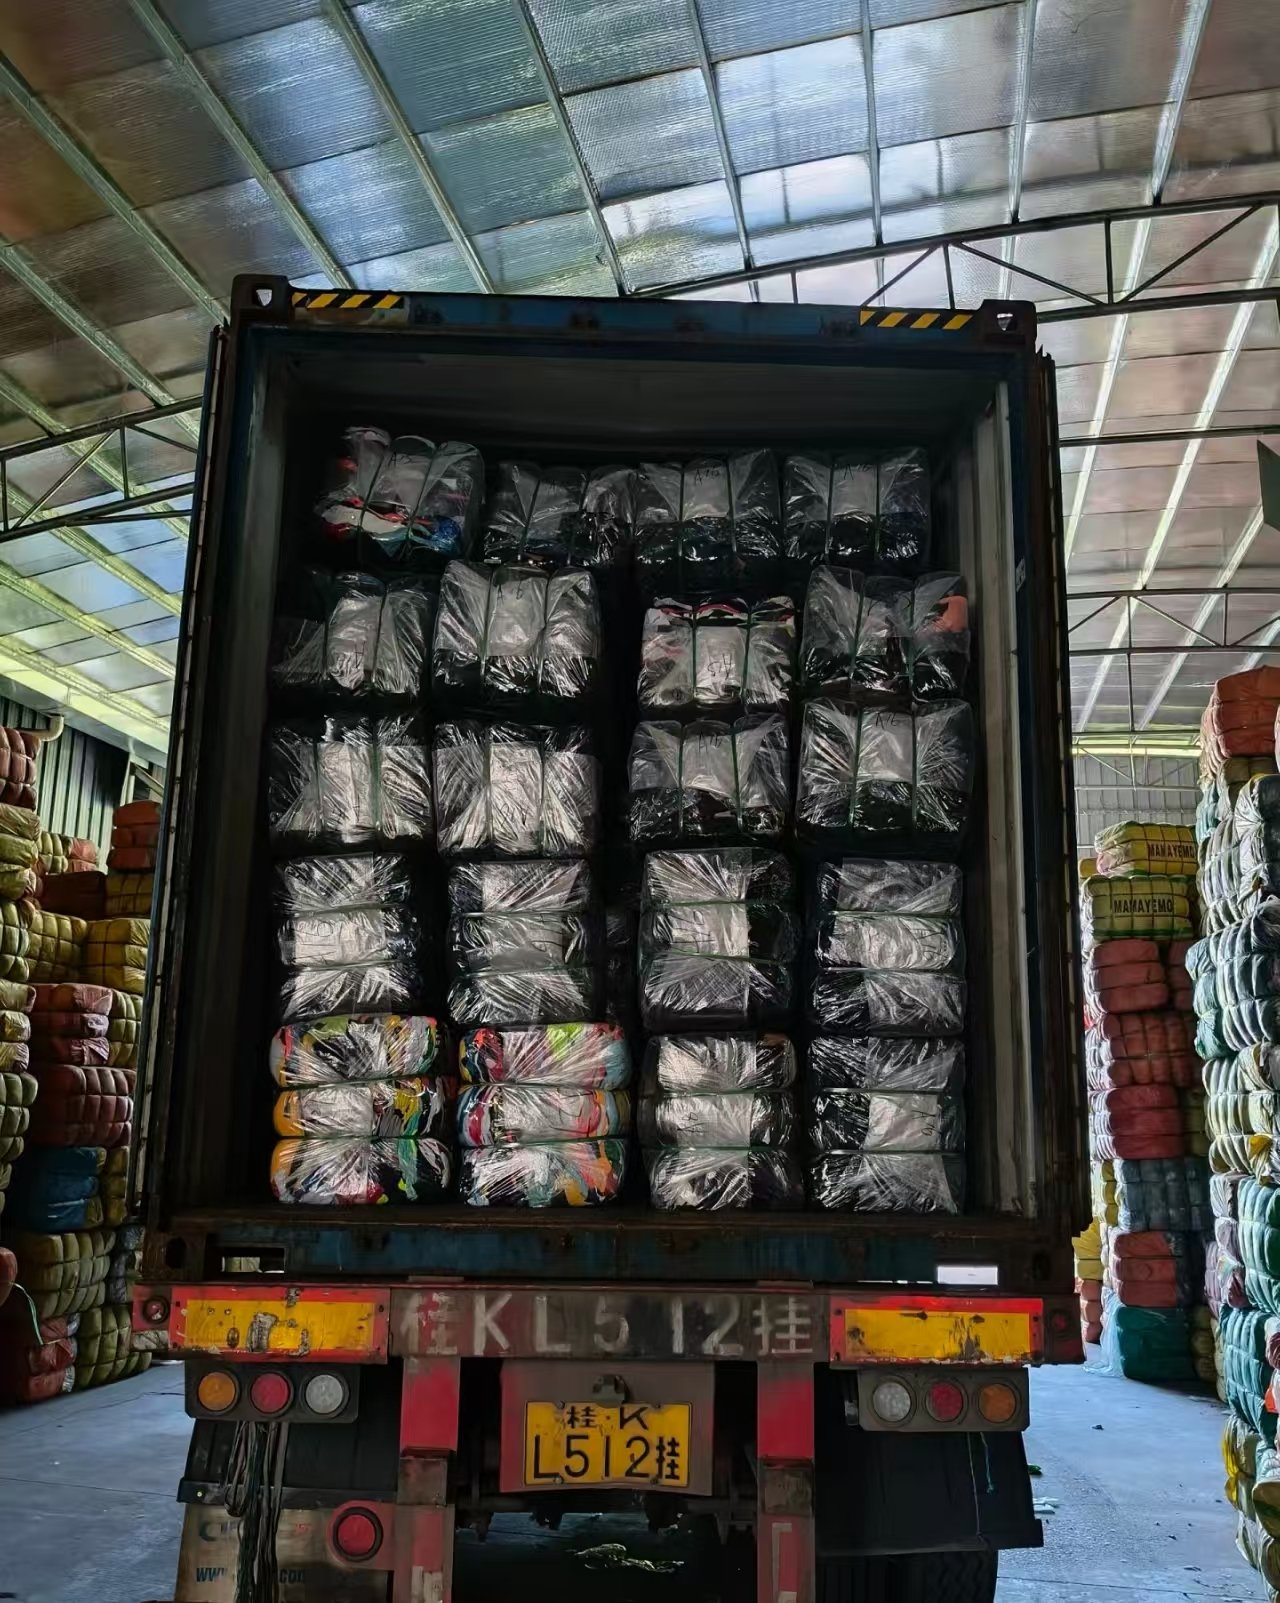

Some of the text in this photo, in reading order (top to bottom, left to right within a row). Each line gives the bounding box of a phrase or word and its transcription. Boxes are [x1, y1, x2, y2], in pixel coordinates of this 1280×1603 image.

[1149, 843, 1195, 859] MAMAYEMO
[1113, 898, 1173, 913] MAMAYEMO
[534, 1434, 680, 1480] L512挂
